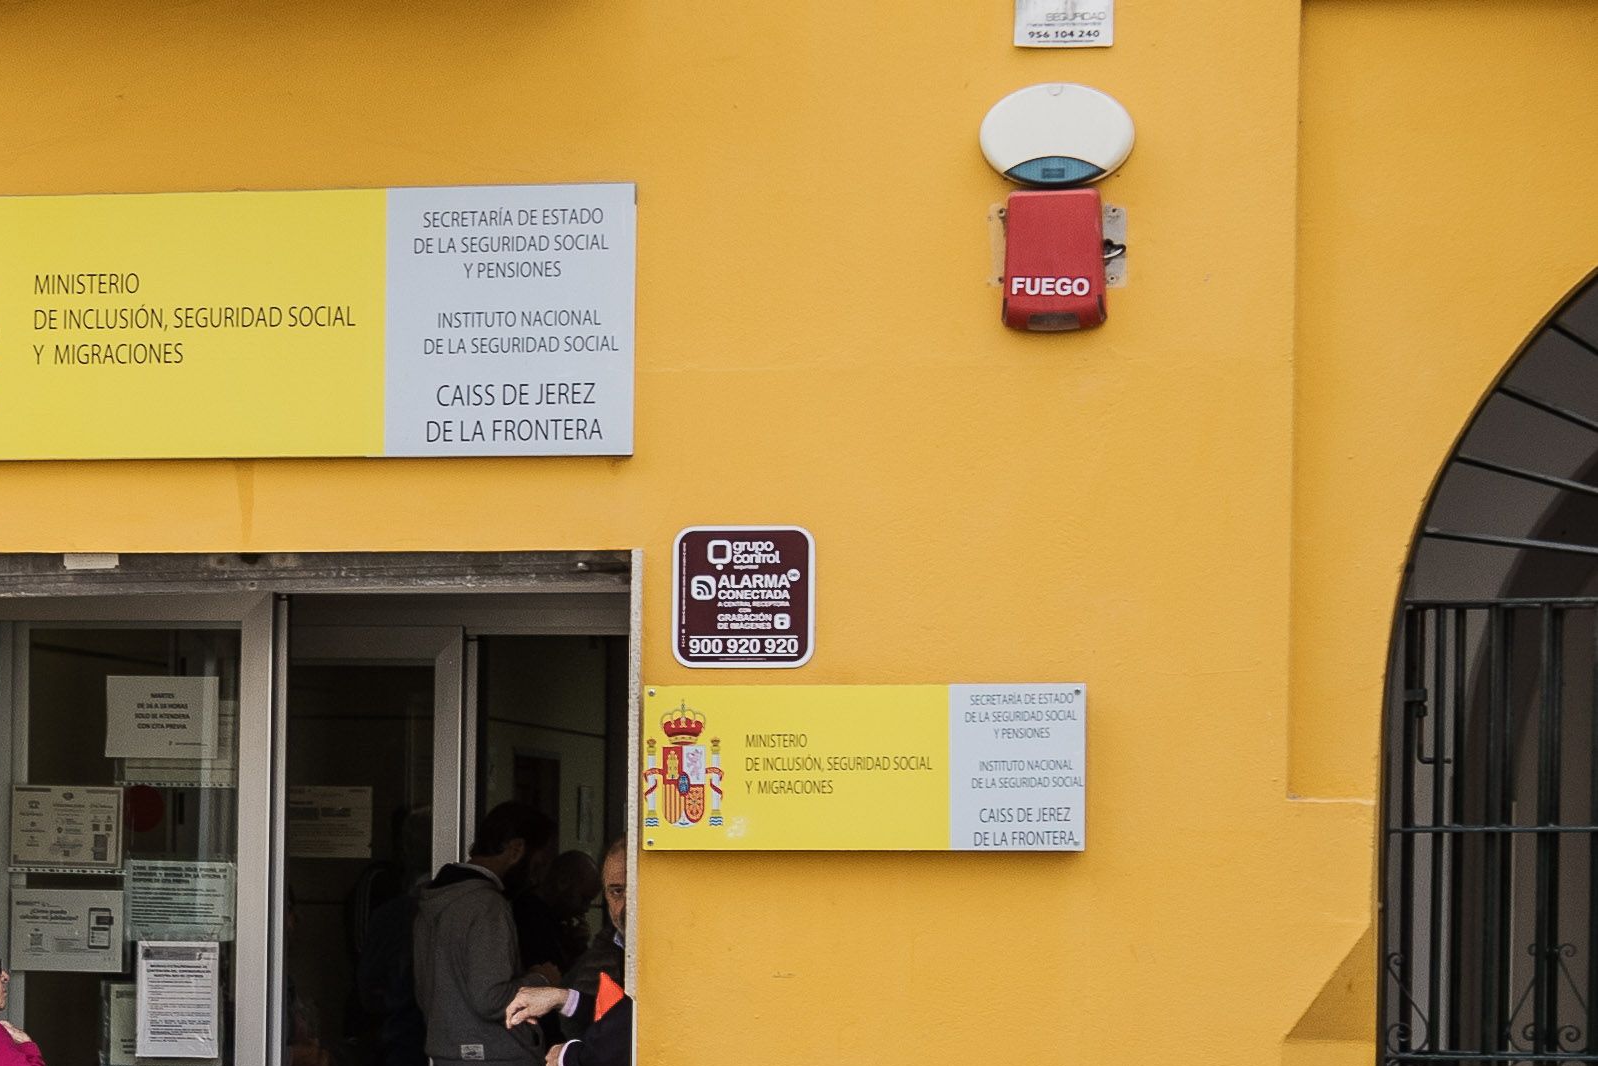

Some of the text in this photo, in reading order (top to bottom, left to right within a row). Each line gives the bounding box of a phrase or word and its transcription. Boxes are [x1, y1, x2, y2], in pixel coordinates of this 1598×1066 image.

[1045, 11, 1107, 21] SEGURIDAD
[1028, 30, 1100, 39] 956 104 240
[422, 206, 604, 229] SECRETARÍA DE ESTADO
[413, 233, 610, 255] DE LA SEGURIDAD SOCIAL
[463, 260, 562, 279] Y PENSIONES
[34, 272, 140, 295] MINISTERIO
[1011, 277, 1090, 297] FUEGO
[33, 303, 356, 331] DE INCLUSIÓN, SEGURIDAD SOCIAL
[437, 309, 602, 329] INSTITUTO NACIONAL
[423, 335, 619, 355] DE LA SEGURIDAD SOCIAL
[32, 342, 184, 365] Y MIGRACIONES
[436, 382, 596, 407] CAISS DE JEREZ
[426, 418, 603, 443] DE LA FRONTERA
[732, 541, 775, 552] grupo
[732, 551, 781, 564] control
[717, 574, 791, 588] ALARMA
[717, 589, 791, 600] CONECTADA
[716, 612, 773, 622] GRABACIÓN
[730, 622, 773, 630] IMÁGENES
[688, 638, 799, 654] 900 920 920
[964, 709, 1078, 724] DE LA SEGURIDAD SOCIAL
[745, 733, 808, 749] MINISTERIO
[993, 727, 1051, 740] Y PENSIONES
[745, 754, 933, 773] DE INCLUSIÓN, SEGURIDAD SOCIAL
[979, 759, 1073, 772] INSTITUTO NACIONAL
[745, 779, 834, 795] Y MIGRACIONES
[971, 776, 1084, 789] DE LA SEGURIDAD SOCIAL
[979, 806, 1071, 824] CAISS DE JEREZ
[973, 830, 1074, 847] DE LA FRONTERA
